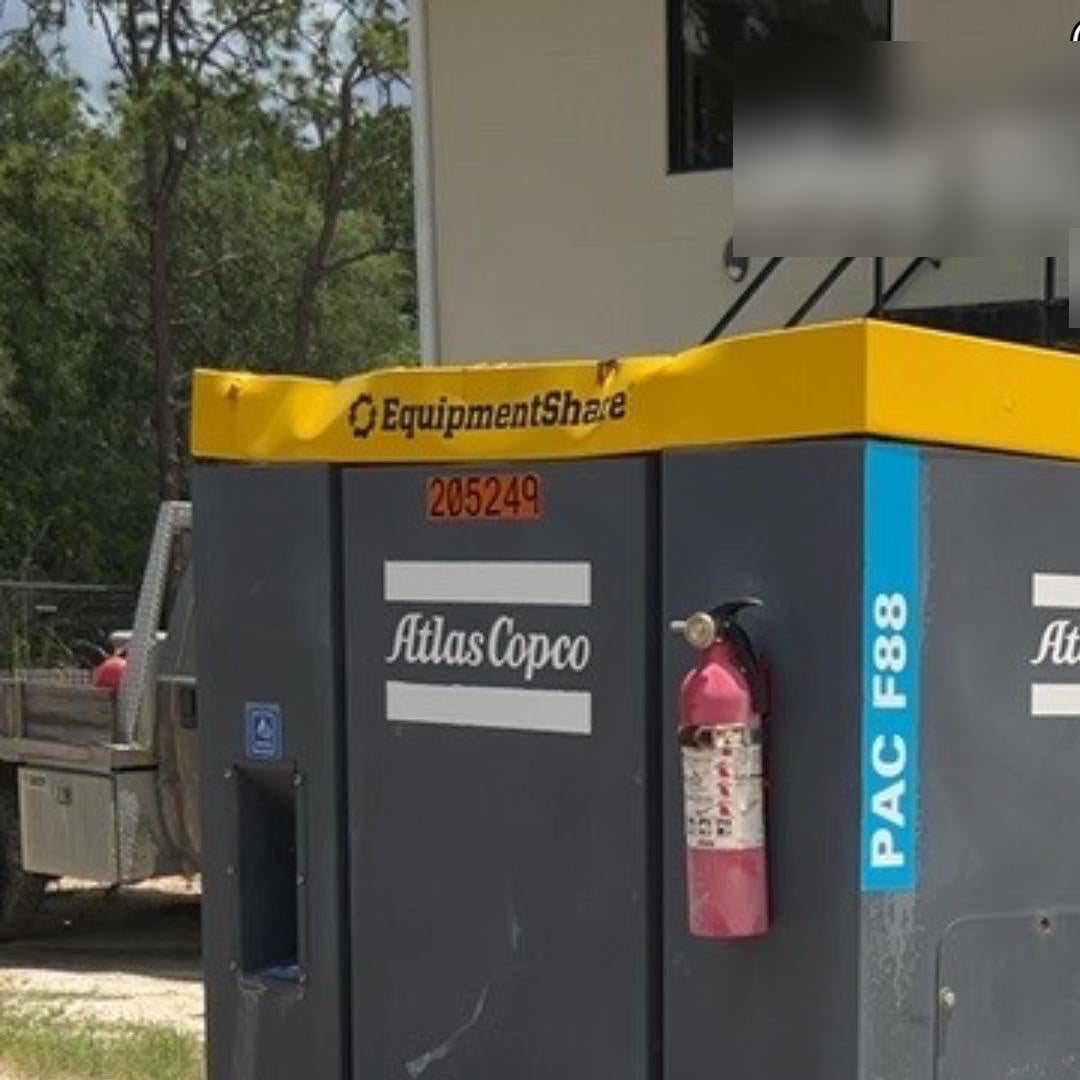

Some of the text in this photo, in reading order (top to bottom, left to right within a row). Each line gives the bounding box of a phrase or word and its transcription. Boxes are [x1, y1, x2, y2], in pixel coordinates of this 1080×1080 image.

[382, 389, 628, 439] EquipmentShare
[430, 474, 539, 517] 205249
[386, 611, 590, 681] Atlas Copco
[870, 592, 909, 868] PAC F88
